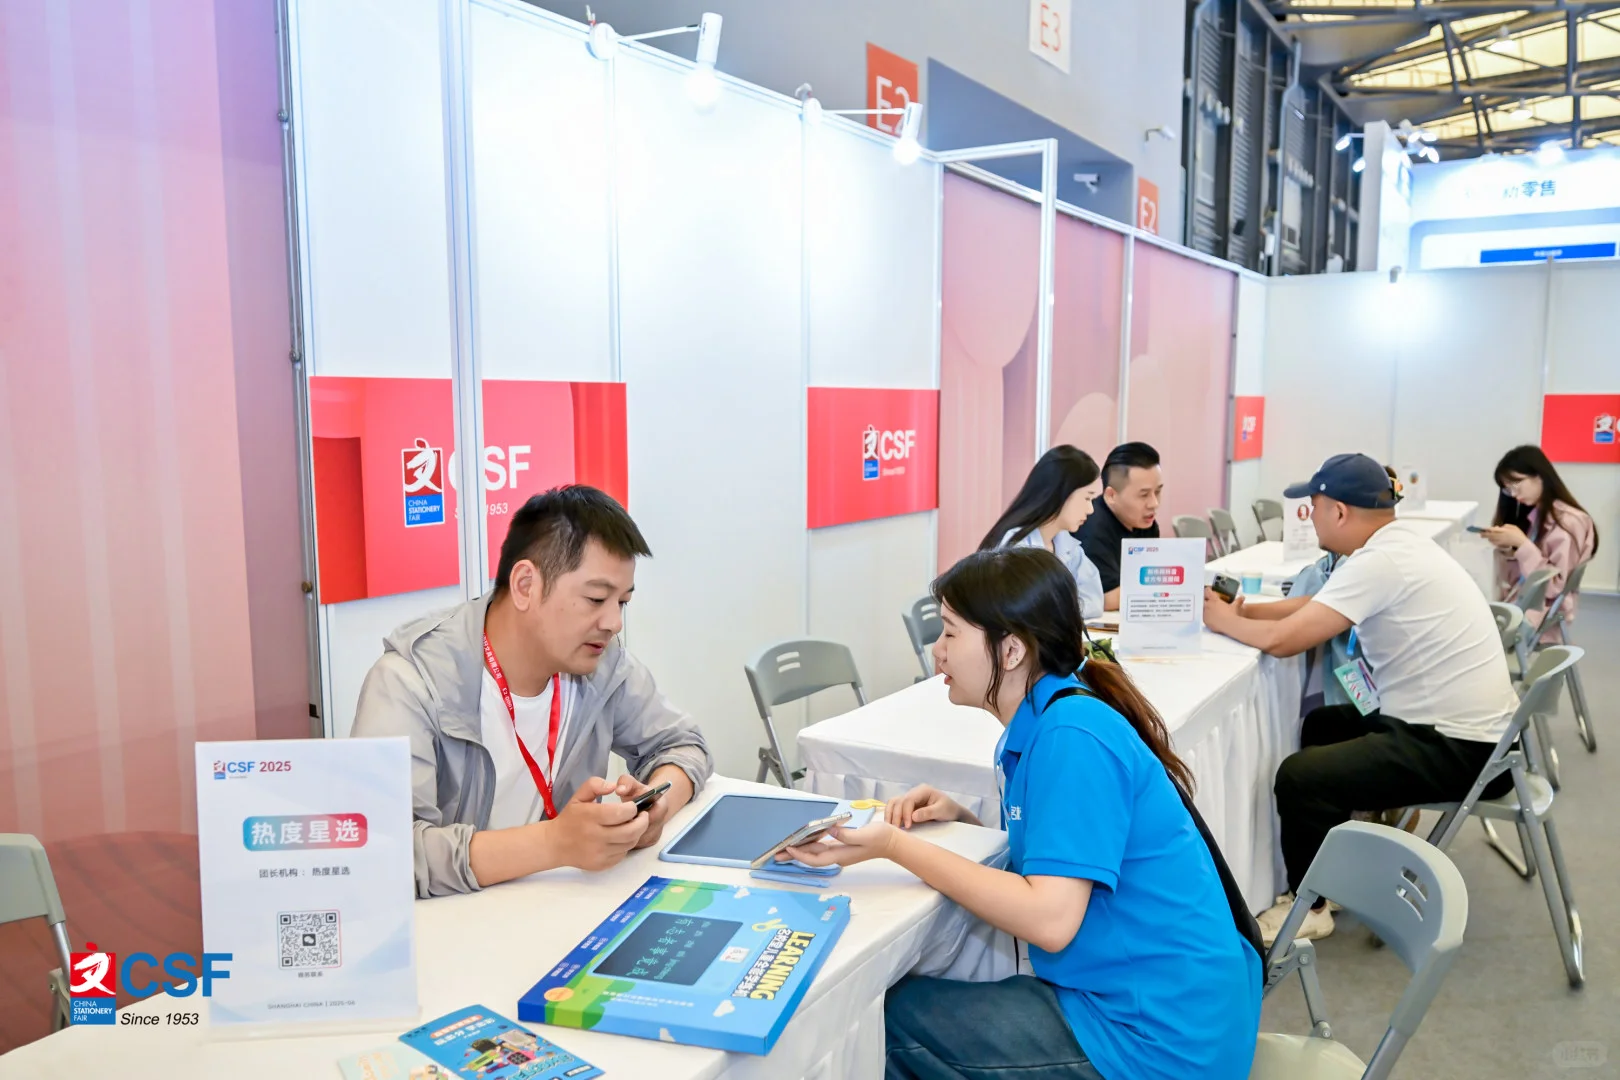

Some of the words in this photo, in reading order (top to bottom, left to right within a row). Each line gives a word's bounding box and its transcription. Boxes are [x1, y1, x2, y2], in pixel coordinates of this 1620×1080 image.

[1040, 4, 1061, 52] E3
[876, 75, 910, 136] E2
[1140, 195, 1156, 234] E2
[880, 430, 916, 460] CSF
[408, 499, 428, 507] CHINA
[408, 505, 440, 514] STATIONERY
[408, 514, 421, 522] FAIR
[227, 761, 256, 773] CSF
[259, 760, 292, 773] 2025
[251, 818, 360, 845] 热度星选
[312, 866, 351, 876] 热度星选
[749, 931, 816, 1001] LEARNING
